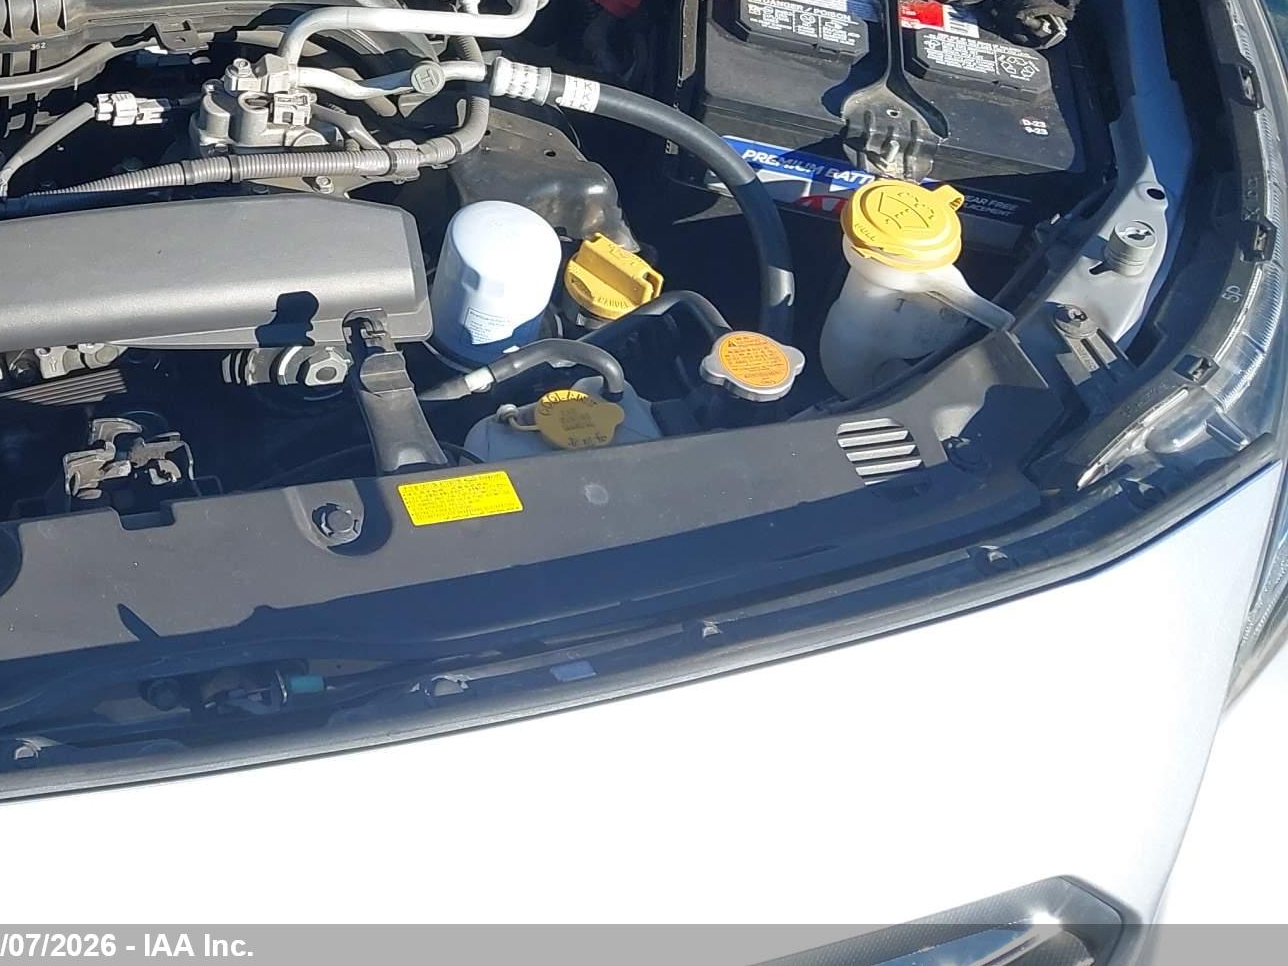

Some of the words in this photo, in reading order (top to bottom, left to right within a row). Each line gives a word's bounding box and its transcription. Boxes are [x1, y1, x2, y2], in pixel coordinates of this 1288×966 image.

[813, 8, 851, 22] POISON
[742, 149, 825, 176] PREMIUM
[965, 194, 989, 207] EAR
[963, 202, 1013, 217] LACEMENT
